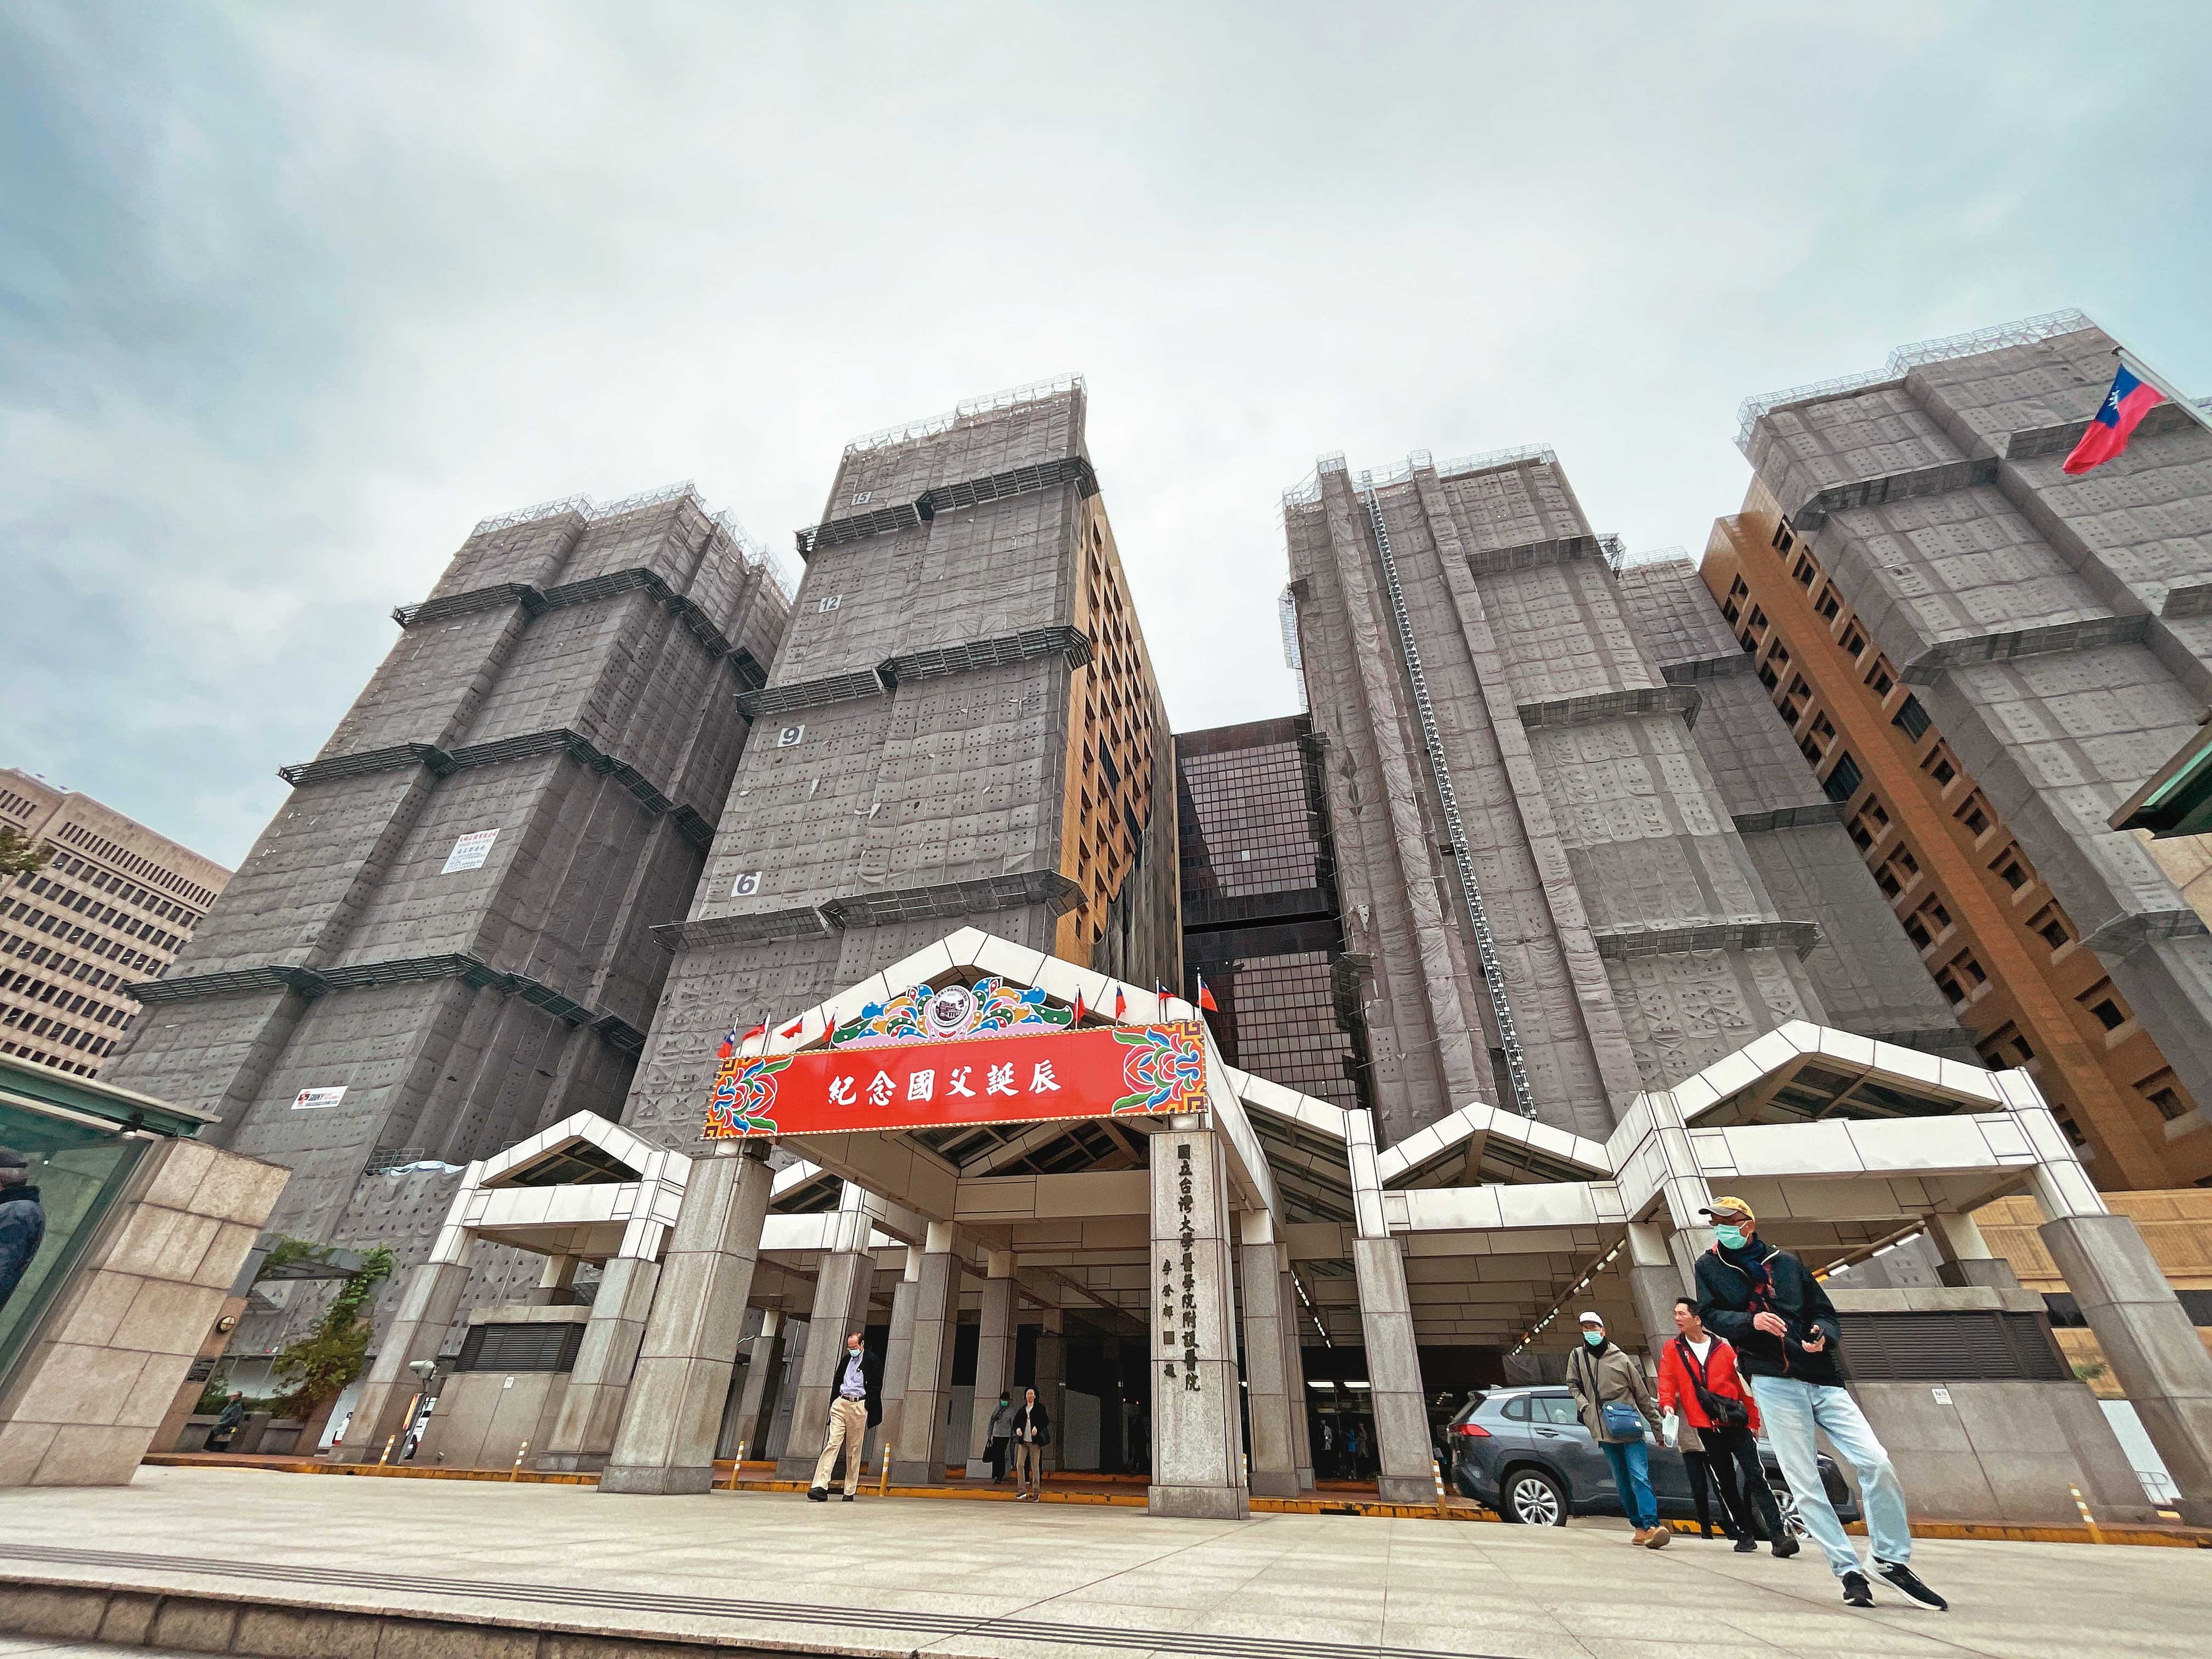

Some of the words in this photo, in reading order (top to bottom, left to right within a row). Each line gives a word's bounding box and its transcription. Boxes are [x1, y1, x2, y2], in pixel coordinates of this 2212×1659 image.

[854, 493, 869, 503] 15
[823, 596, 839, 611] 12
[782, 728, 800, 744] 9
[737, 874, 756, 894] 6
[828, 1059, 1062, 1106] 紀念國父誕辰
